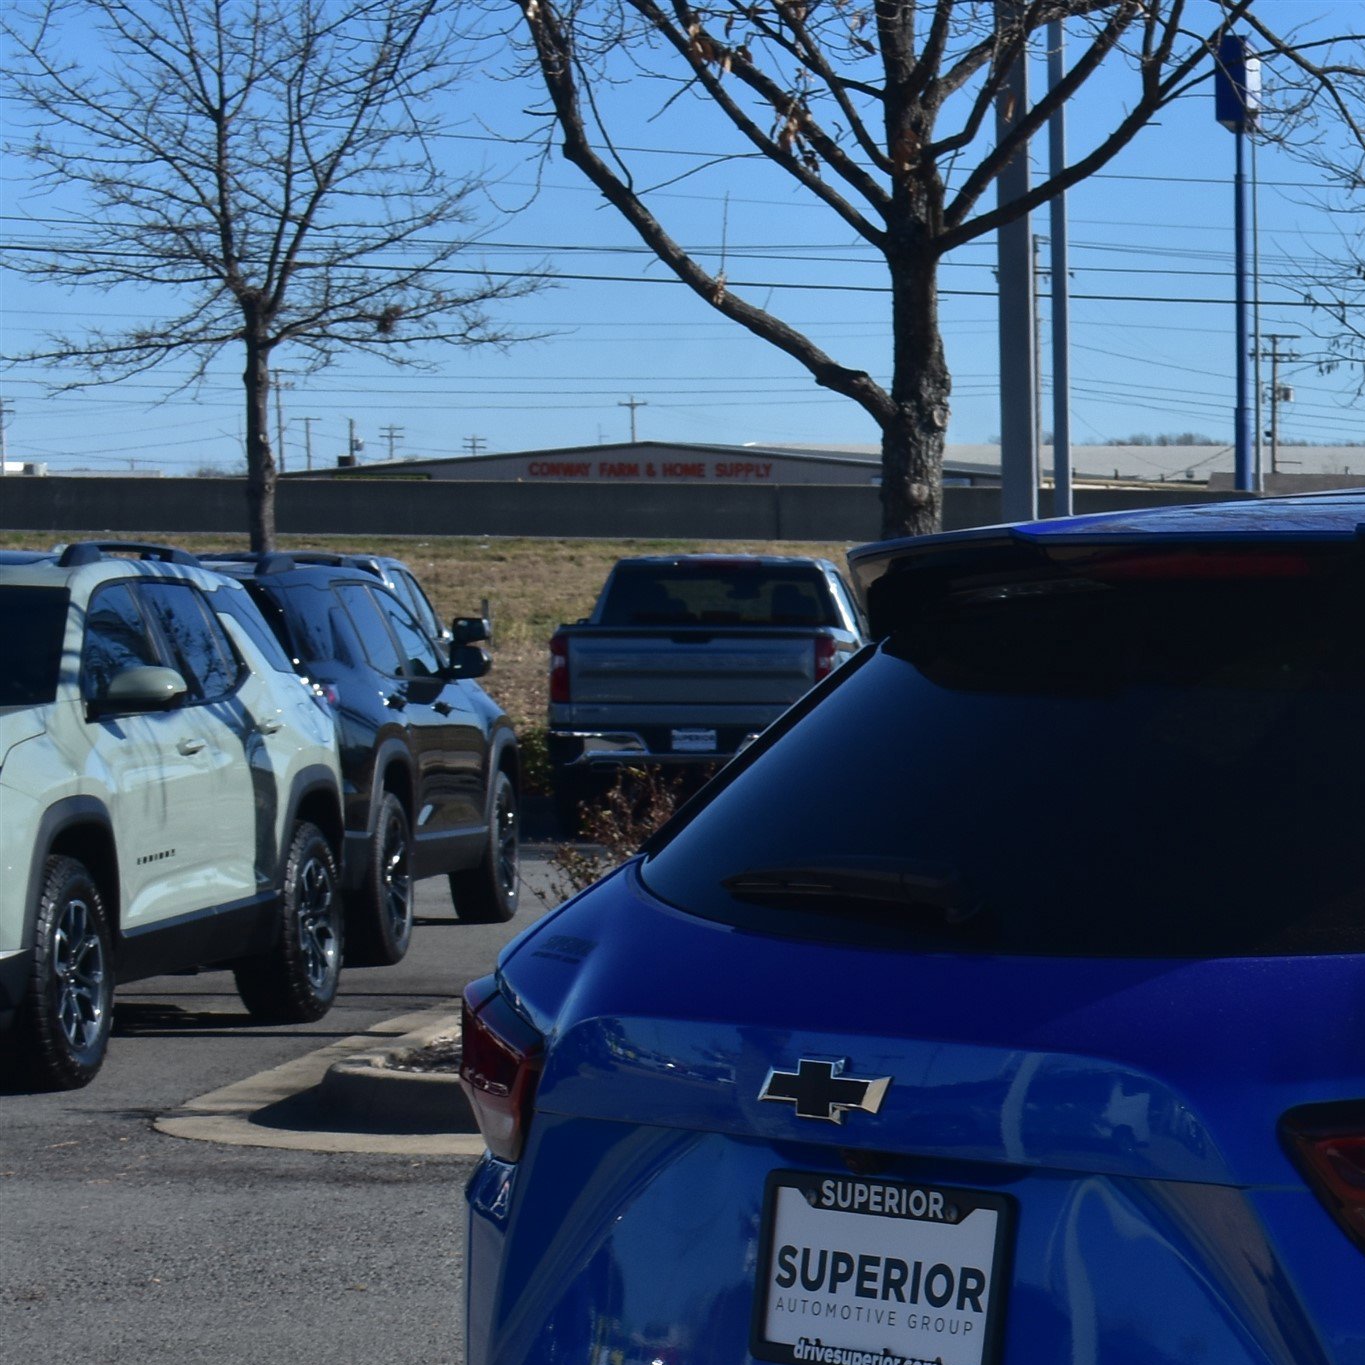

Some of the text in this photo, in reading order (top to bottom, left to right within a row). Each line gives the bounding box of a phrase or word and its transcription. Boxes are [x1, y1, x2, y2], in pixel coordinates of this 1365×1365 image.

[528, 462, 773, 478] CONWAY FARM & HOME SUPPLY
[820, 1179, 945, 1220] SUPERIOR
[774, 1244, 987, 1314] SUPERIOR
[775, 1296, 974, 1337] AUTOMOTIVE GROUP
